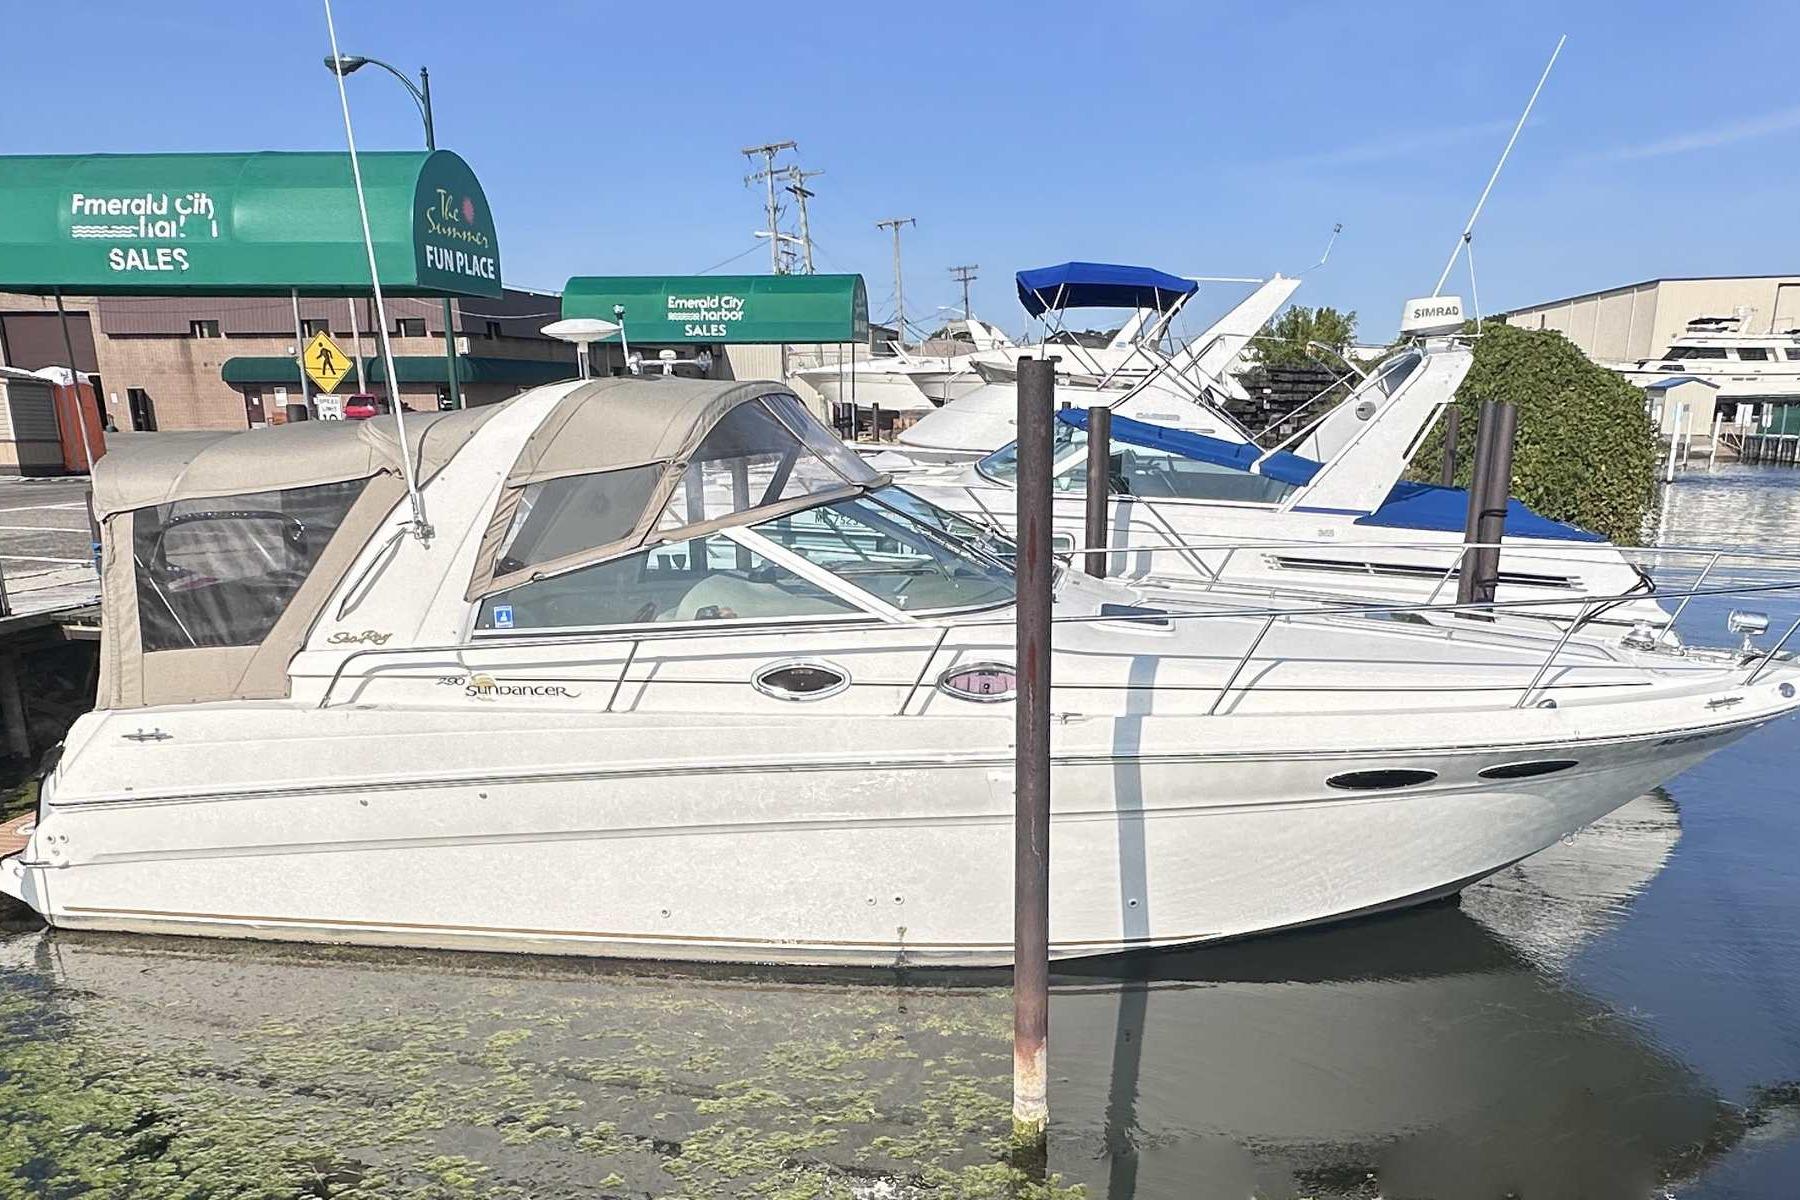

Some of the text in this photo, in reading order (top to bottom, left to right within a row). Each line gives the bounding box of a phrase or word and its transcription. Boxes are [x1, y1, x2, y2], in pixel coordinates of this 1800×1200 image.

[437, 189, 459, 222] The
[426, 206, 489, 249] Summer
[109, 248, 190, 271] SALES
[425, 245, 496, 280] FUN PLACE
[668, 295, 745, 311] Emerald City
[1413, 306, 1459, 319] SIMRAD
[700, 308, 744, 321] harbor
[684, 324, 727, 337] SALES
